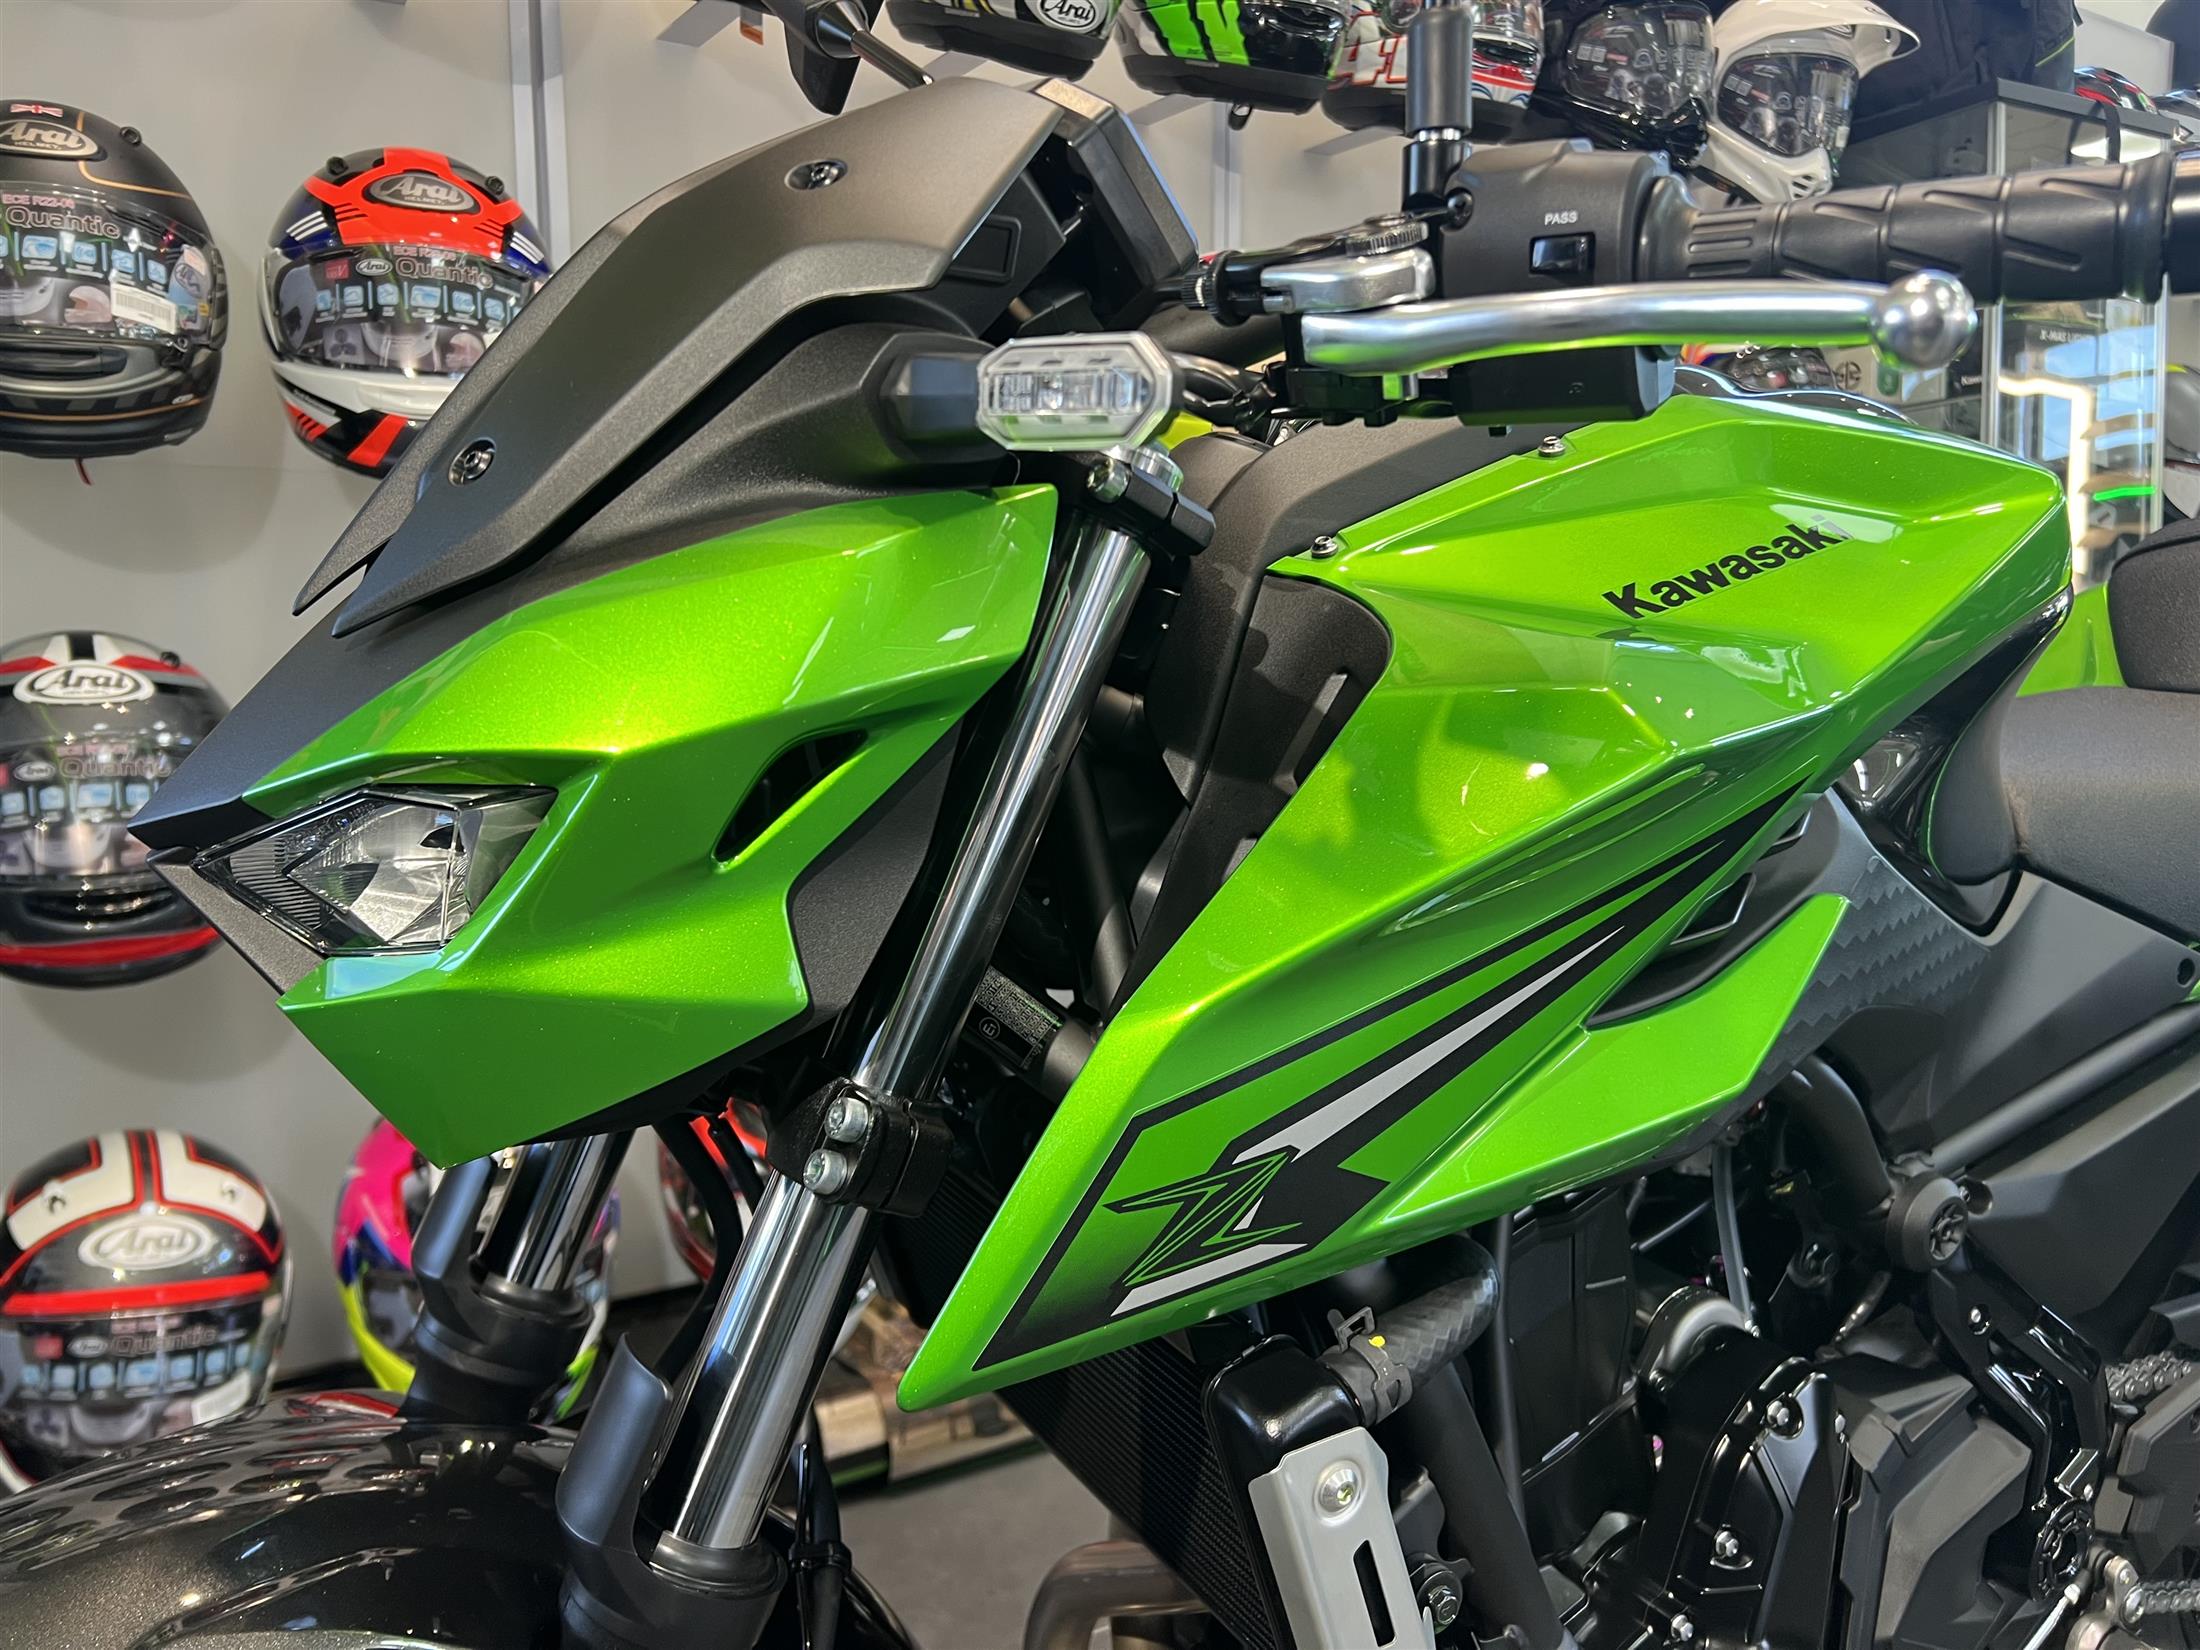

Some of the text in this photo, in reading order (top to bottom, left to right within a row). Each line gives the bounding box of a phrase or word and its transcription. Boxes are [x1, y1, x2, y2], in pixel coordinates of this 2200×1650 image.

[1043, 0, 1090, 20] Arai
[0, 121, 82, 148] Arai
[381, 176, 462, 203] Arai
[5, 205, 122, 239] Quantic
[1544, 210, 1578, 226] PASS
[395, 257, 493, 289] Quantic
[1601, 513, 1853, 619] Kawasaki
[33, 669, 126, 692] Arai
[98, 1226, 187, 1255] Arai
